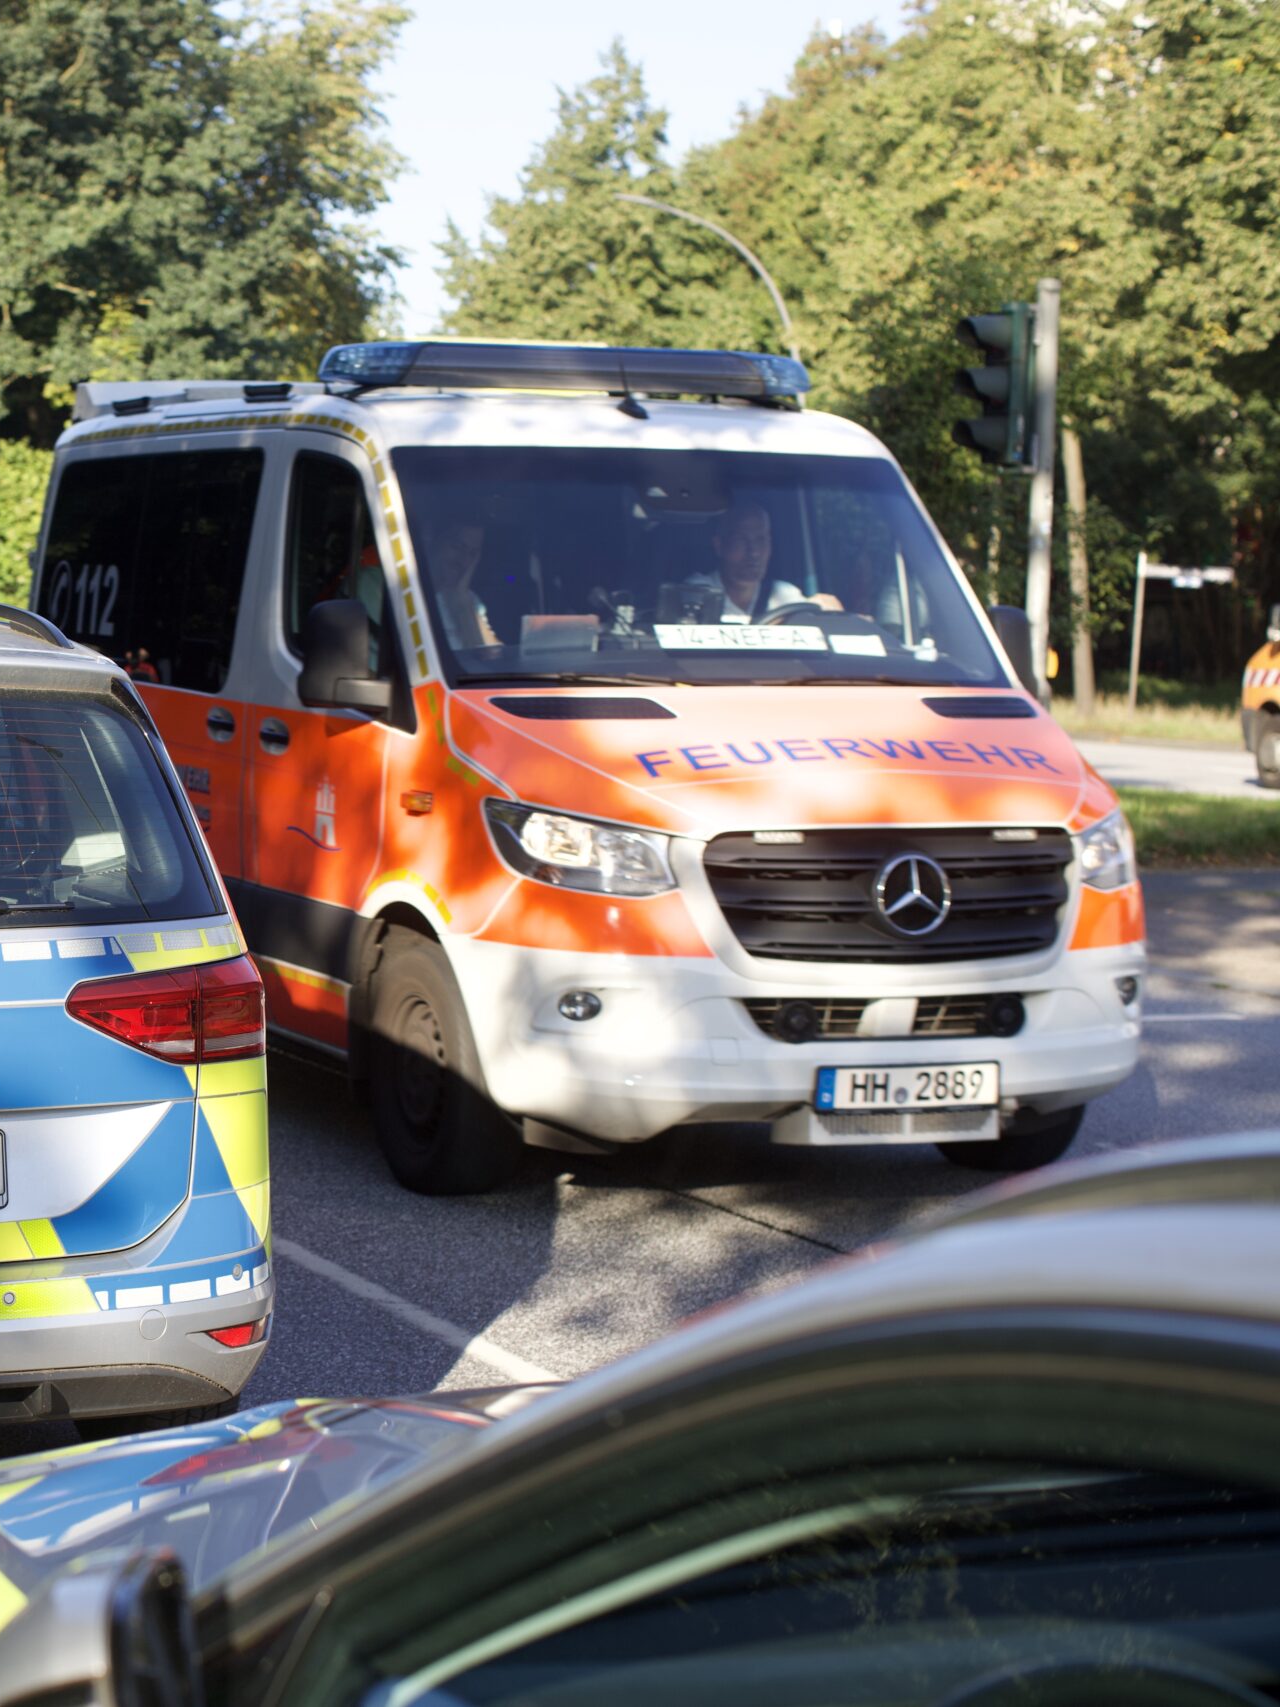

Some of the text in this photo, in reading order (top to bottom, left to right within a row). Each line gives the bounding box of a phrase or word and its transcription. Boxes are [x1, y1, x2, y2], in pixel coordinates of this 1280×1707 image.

[76, 564, 119, 636] 112
[635, 738, 1062, 778] FEUERWEHR
[851, 1070, 984, 1103] HH 2889
